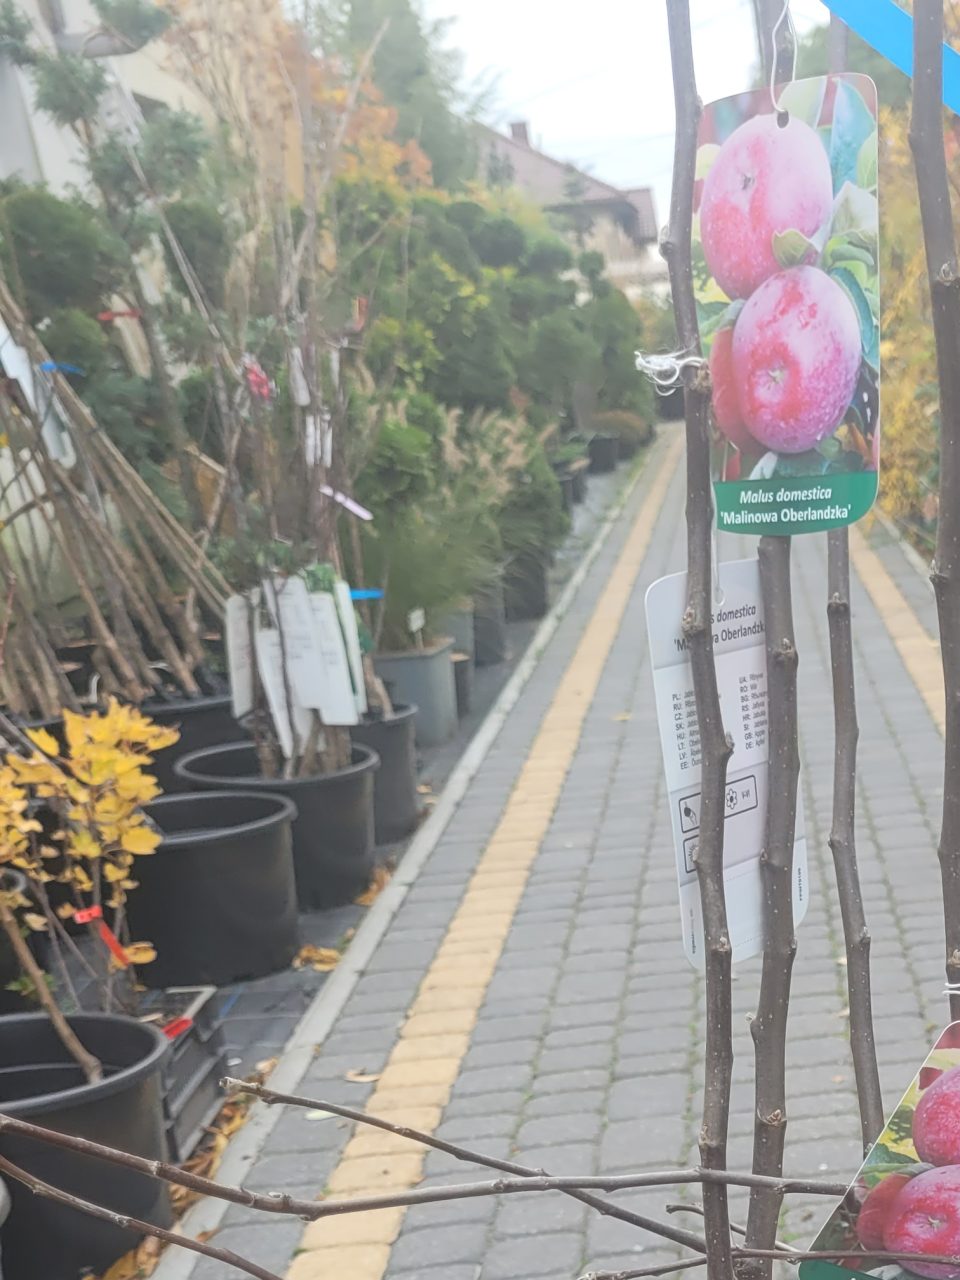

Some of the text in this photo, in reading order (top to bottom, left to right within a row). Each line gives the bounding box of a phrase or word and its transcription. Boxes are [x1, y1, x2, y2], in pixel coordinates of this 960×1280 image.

[739, 486, 832, 504] Malus domestica
[720, 504, 852, 525] 'Malinowa Oberlandzka'
[716, 604, 756, 623] domestica
[721, 620, 767, 642] Oberlandzk
